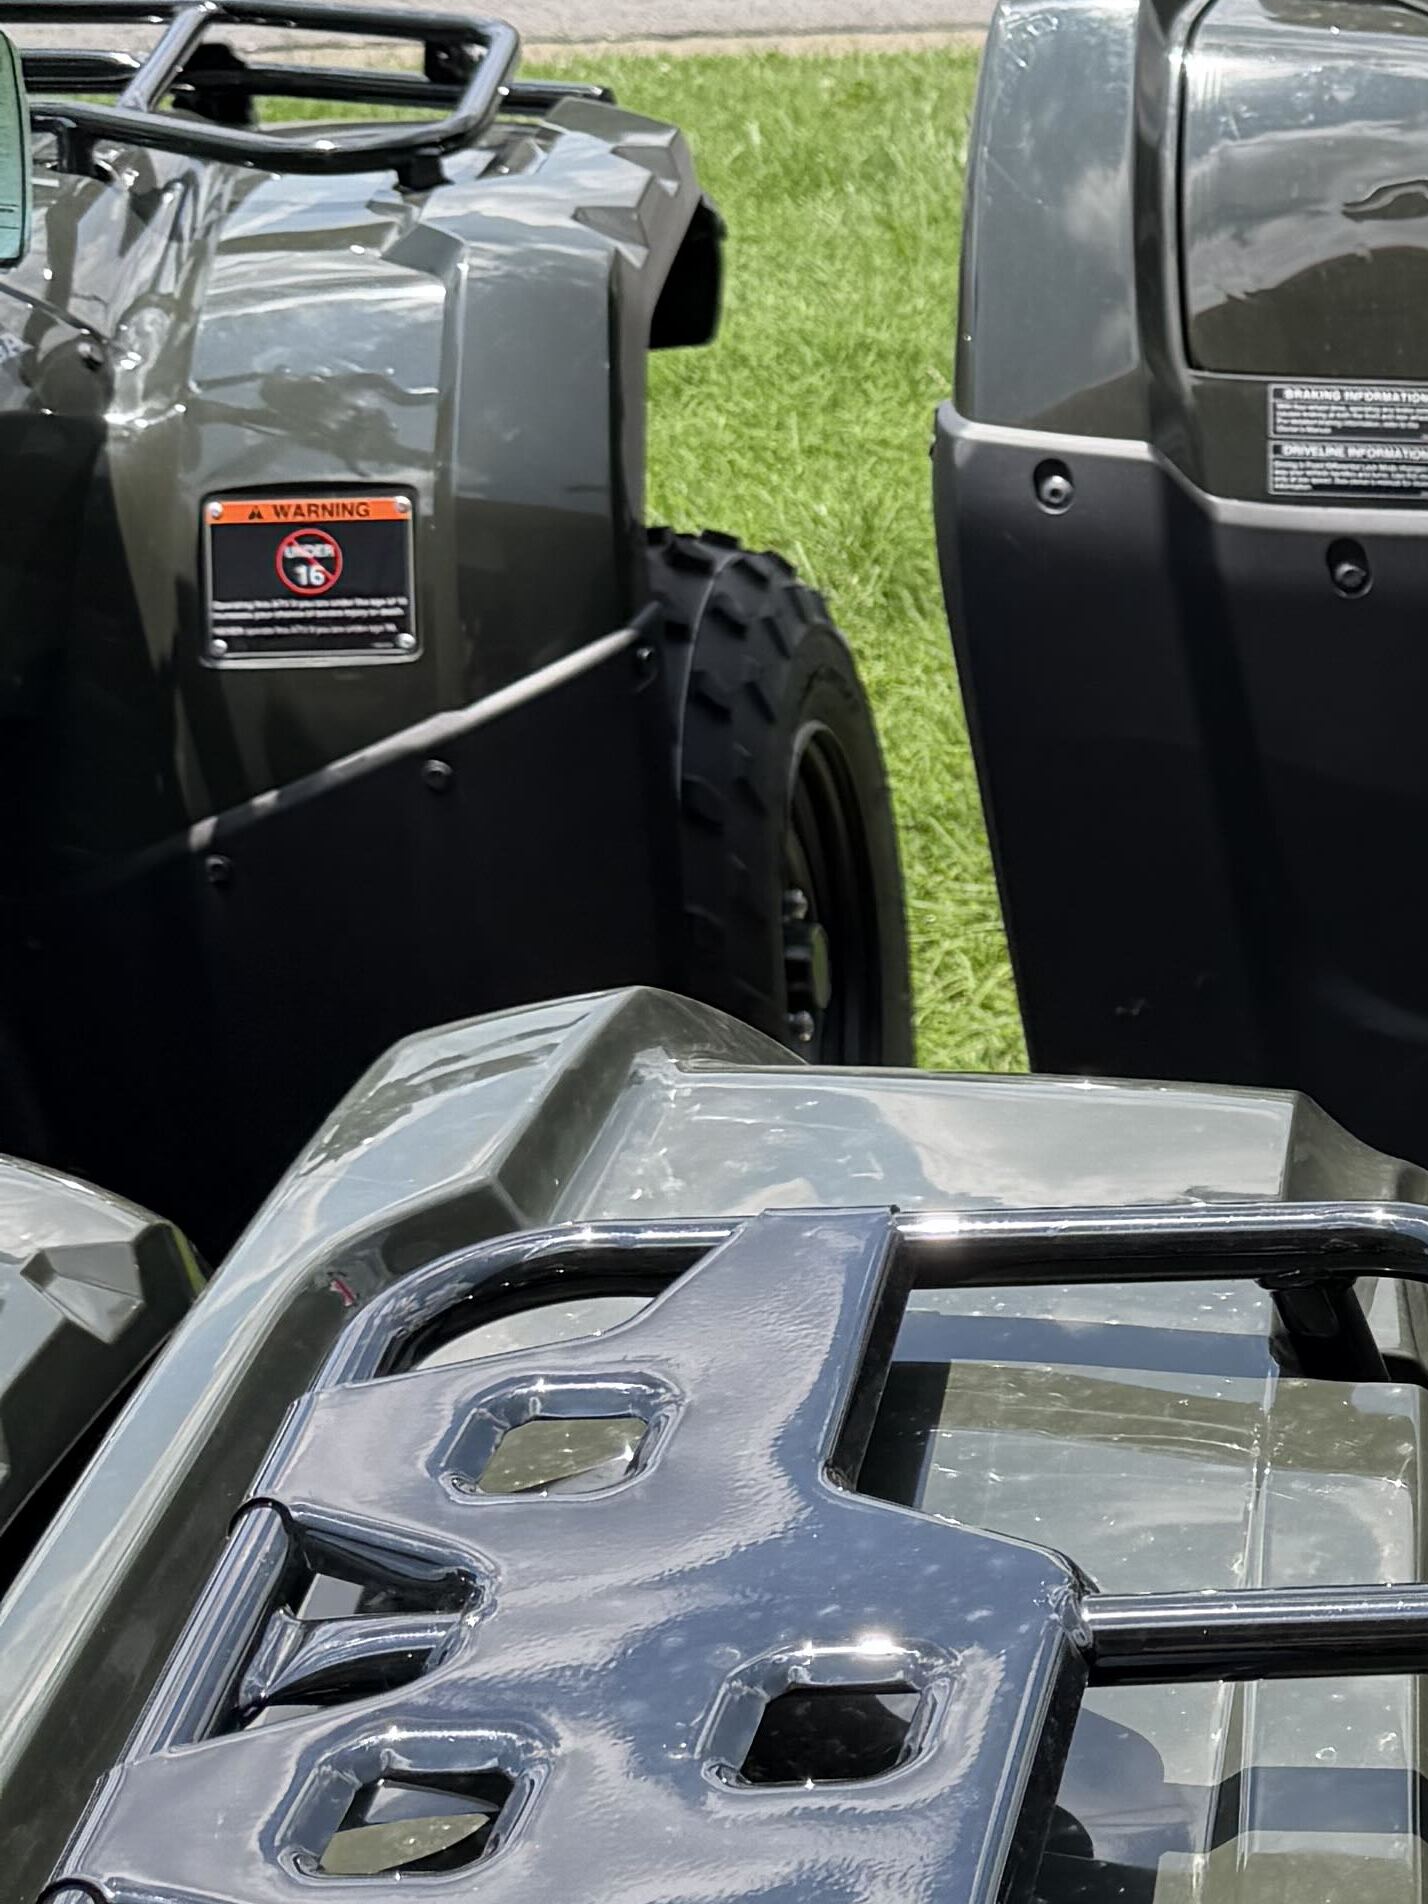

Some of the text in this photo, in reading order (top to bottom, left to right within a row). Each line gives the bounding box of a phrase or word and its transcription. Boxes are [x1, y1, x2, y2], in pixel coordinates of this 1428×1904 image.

[1283, 388, 1341, 401] BRAKING
[272, 502, 370, 518] WARNING
[294, 565, 325, 586] 16
